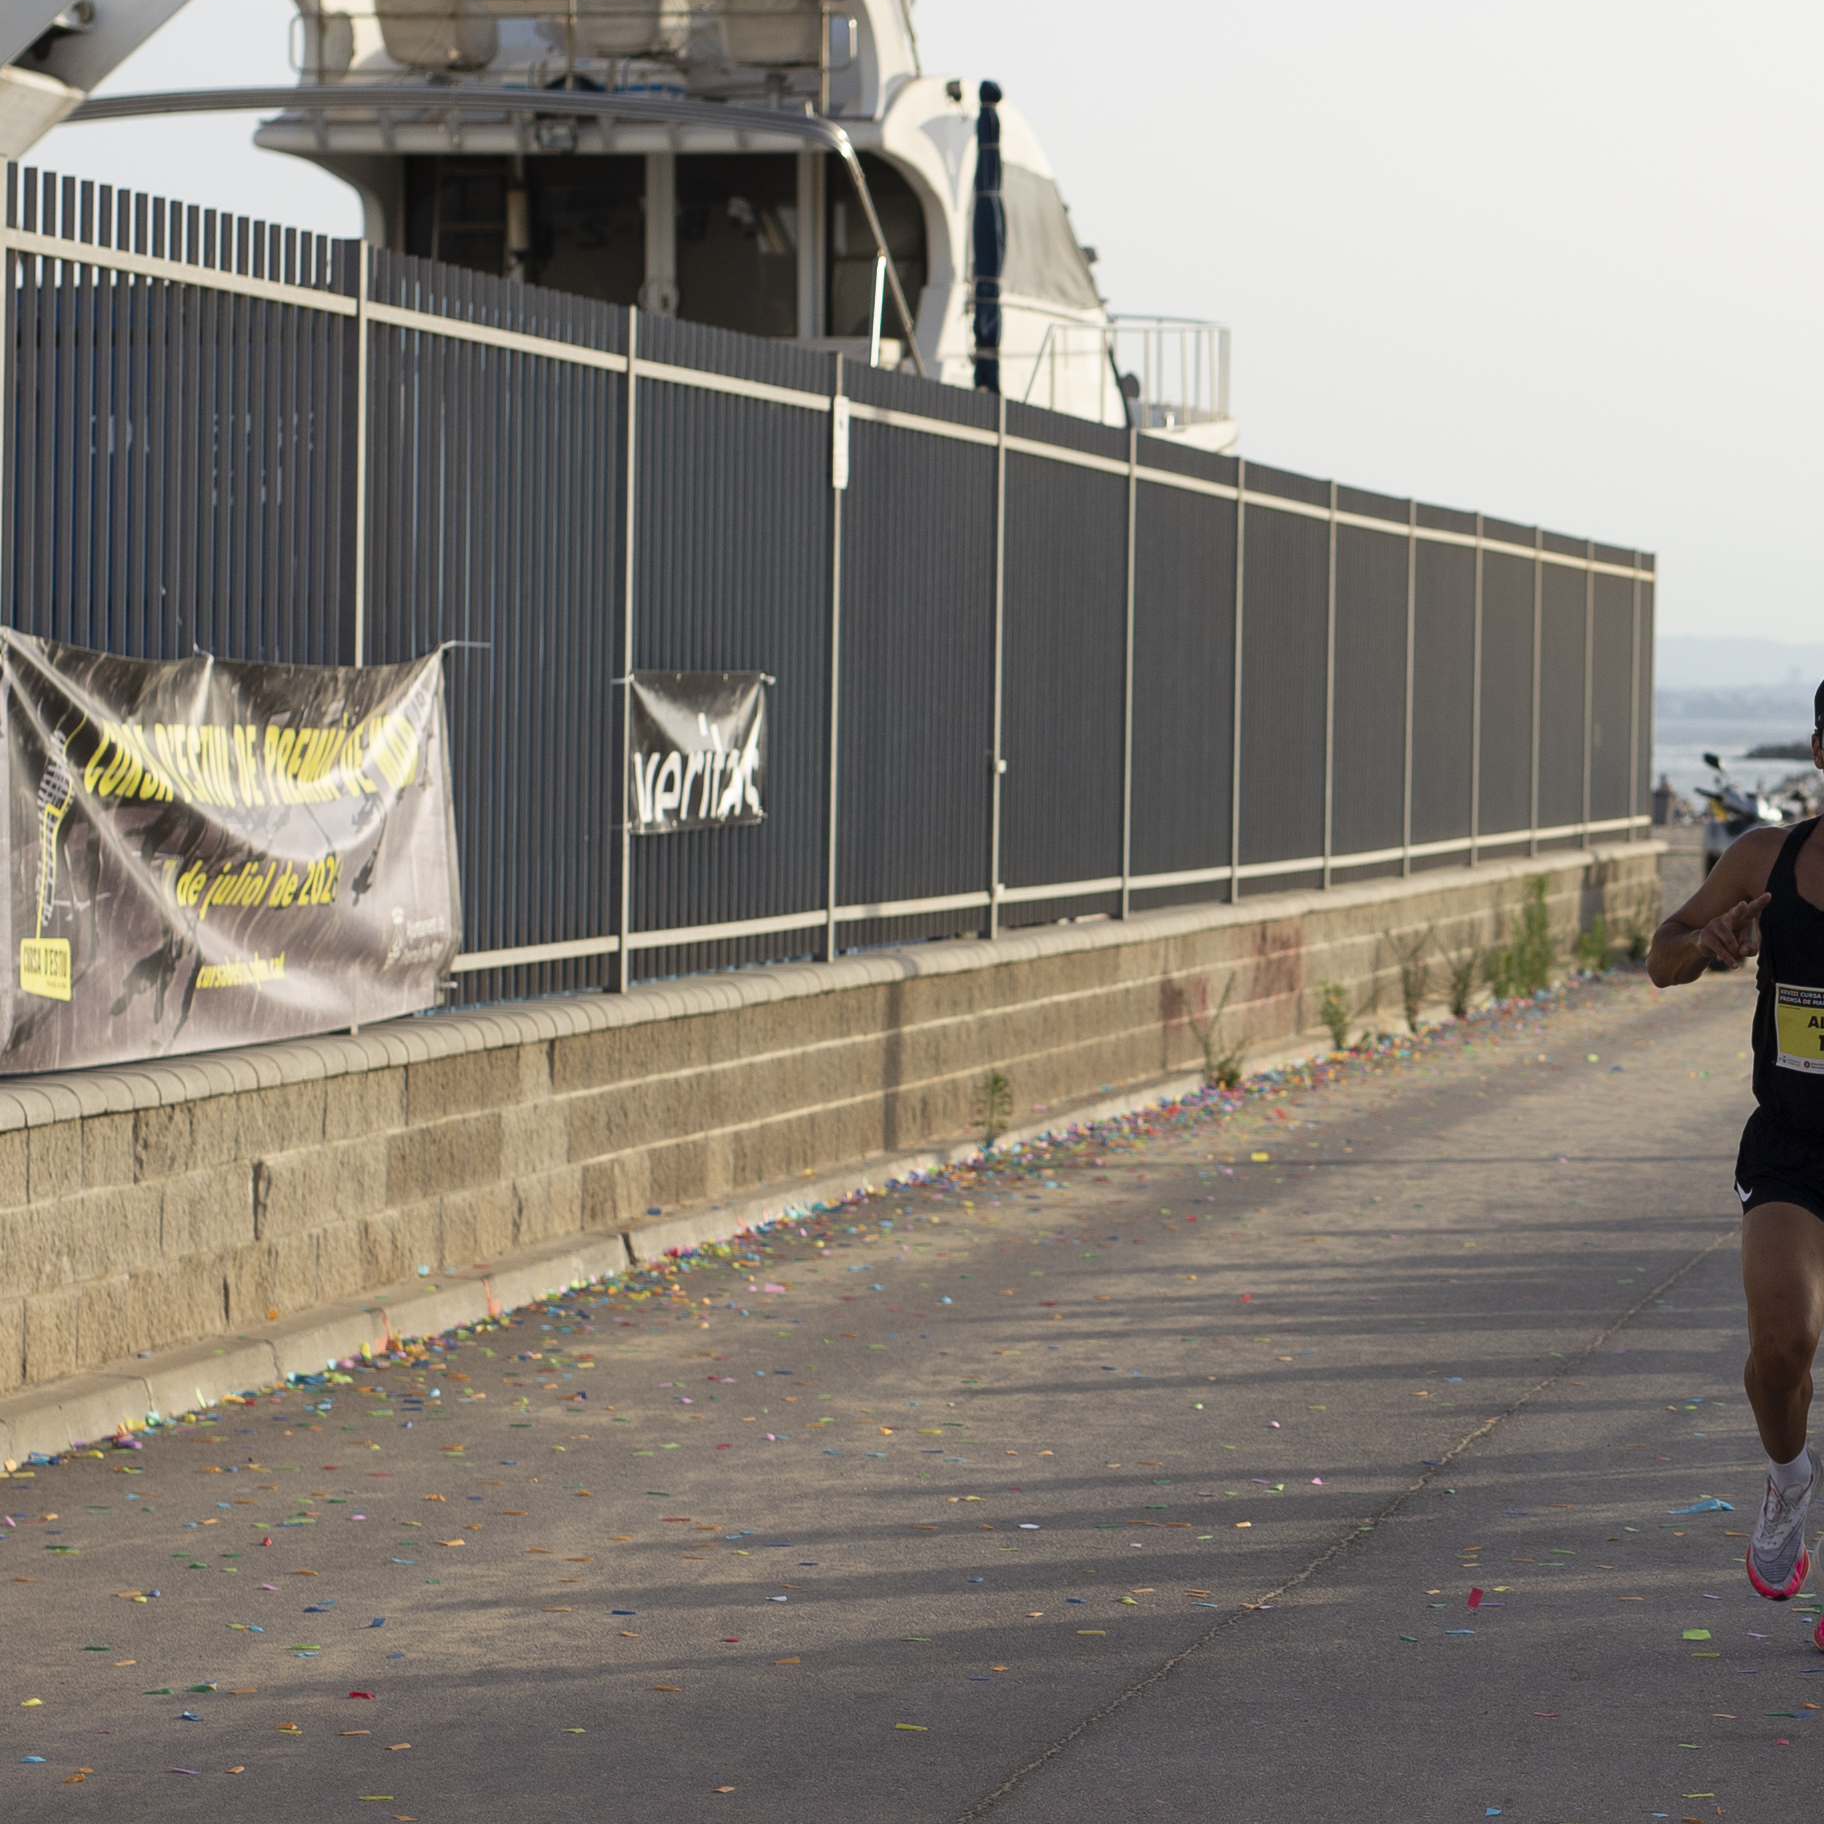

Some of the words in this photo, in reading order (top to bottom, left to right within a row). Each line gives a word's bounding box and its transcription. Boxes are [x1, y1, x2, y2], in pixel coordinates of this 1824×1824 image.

[176, 859, 207, 908] de
[198, 860, 277, 921] juliol
[267, 860, 299, 908] de
[1802, 998, 1812, 1006] DE
